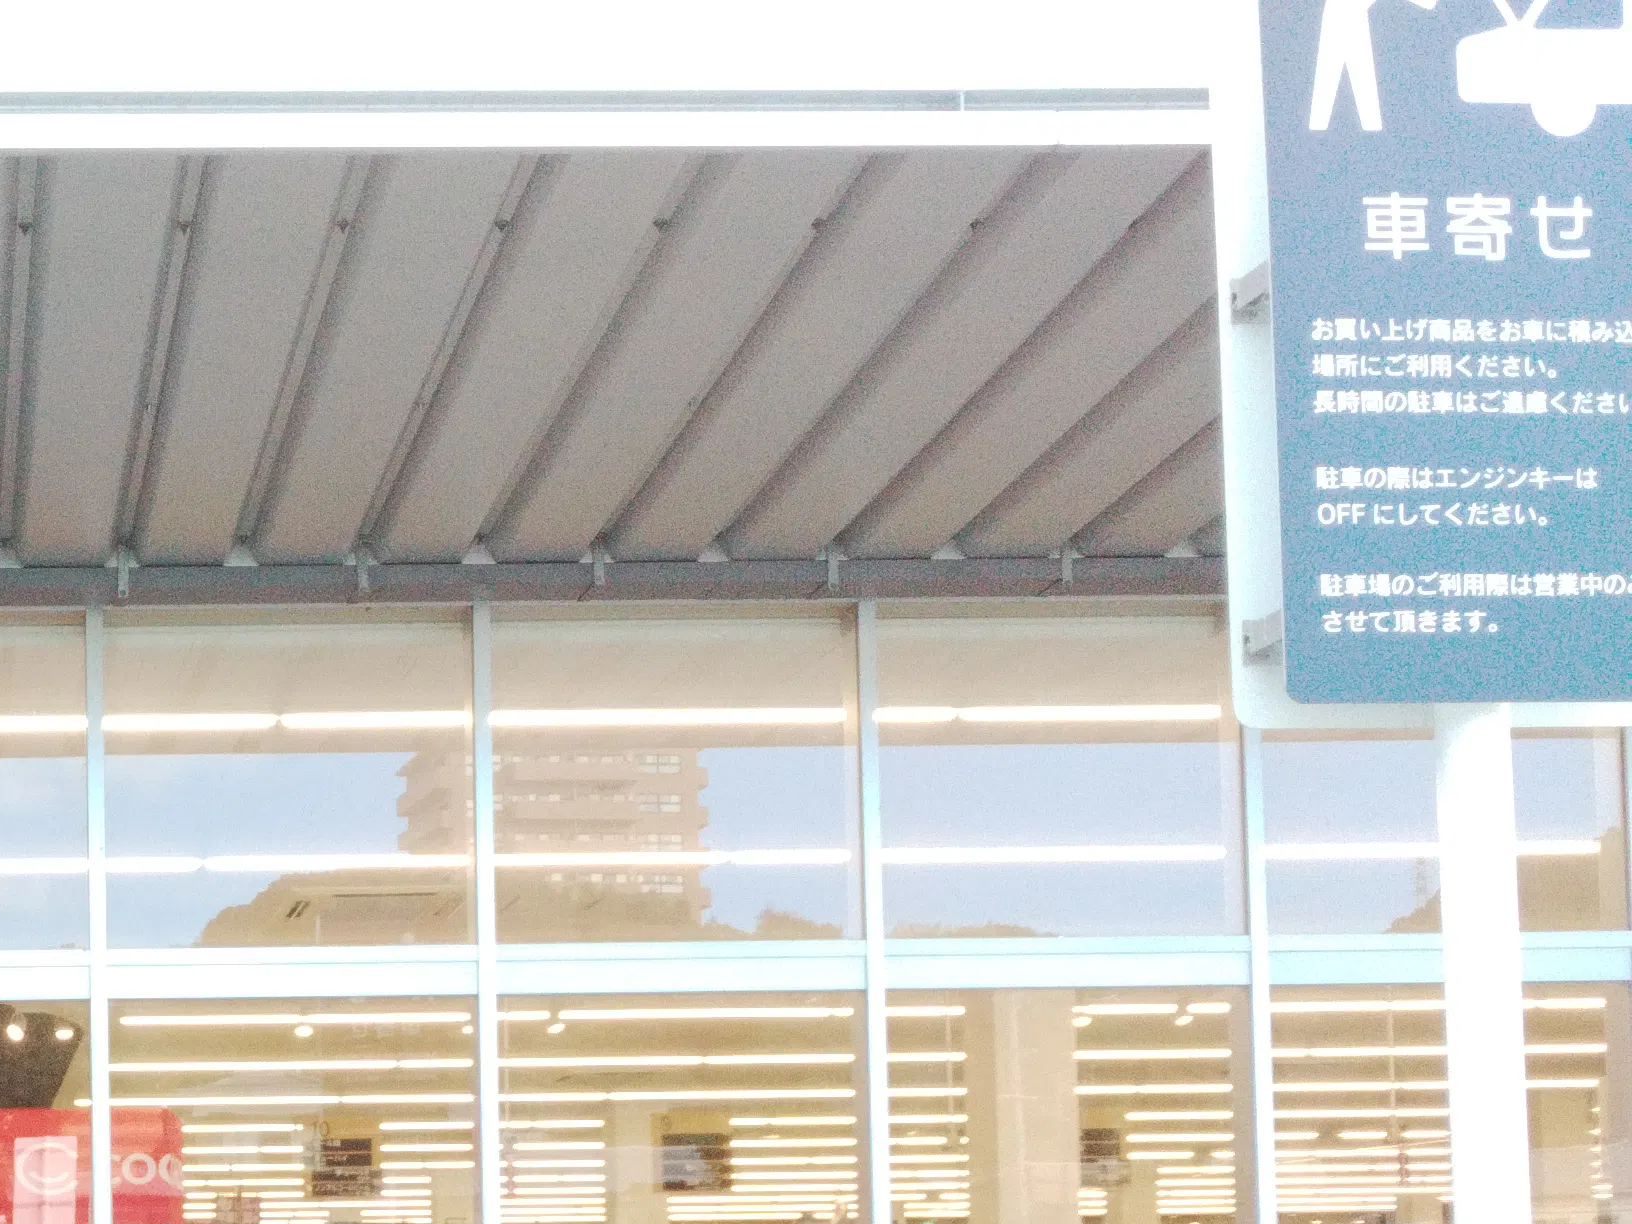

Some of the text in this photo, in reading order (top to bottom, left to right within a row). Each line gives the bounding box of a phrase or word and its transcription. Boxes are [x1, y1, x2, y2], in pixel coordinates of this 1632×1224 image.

[1362, 191, 1593, 261] 車寄せ
[1313, 354, 1557, 378] 場所にご利用ください。
[1316, 466, 1598, 489] 駐車の際はエンジンキーは
[1322, 610, 1498, 633] させて頂きます。
